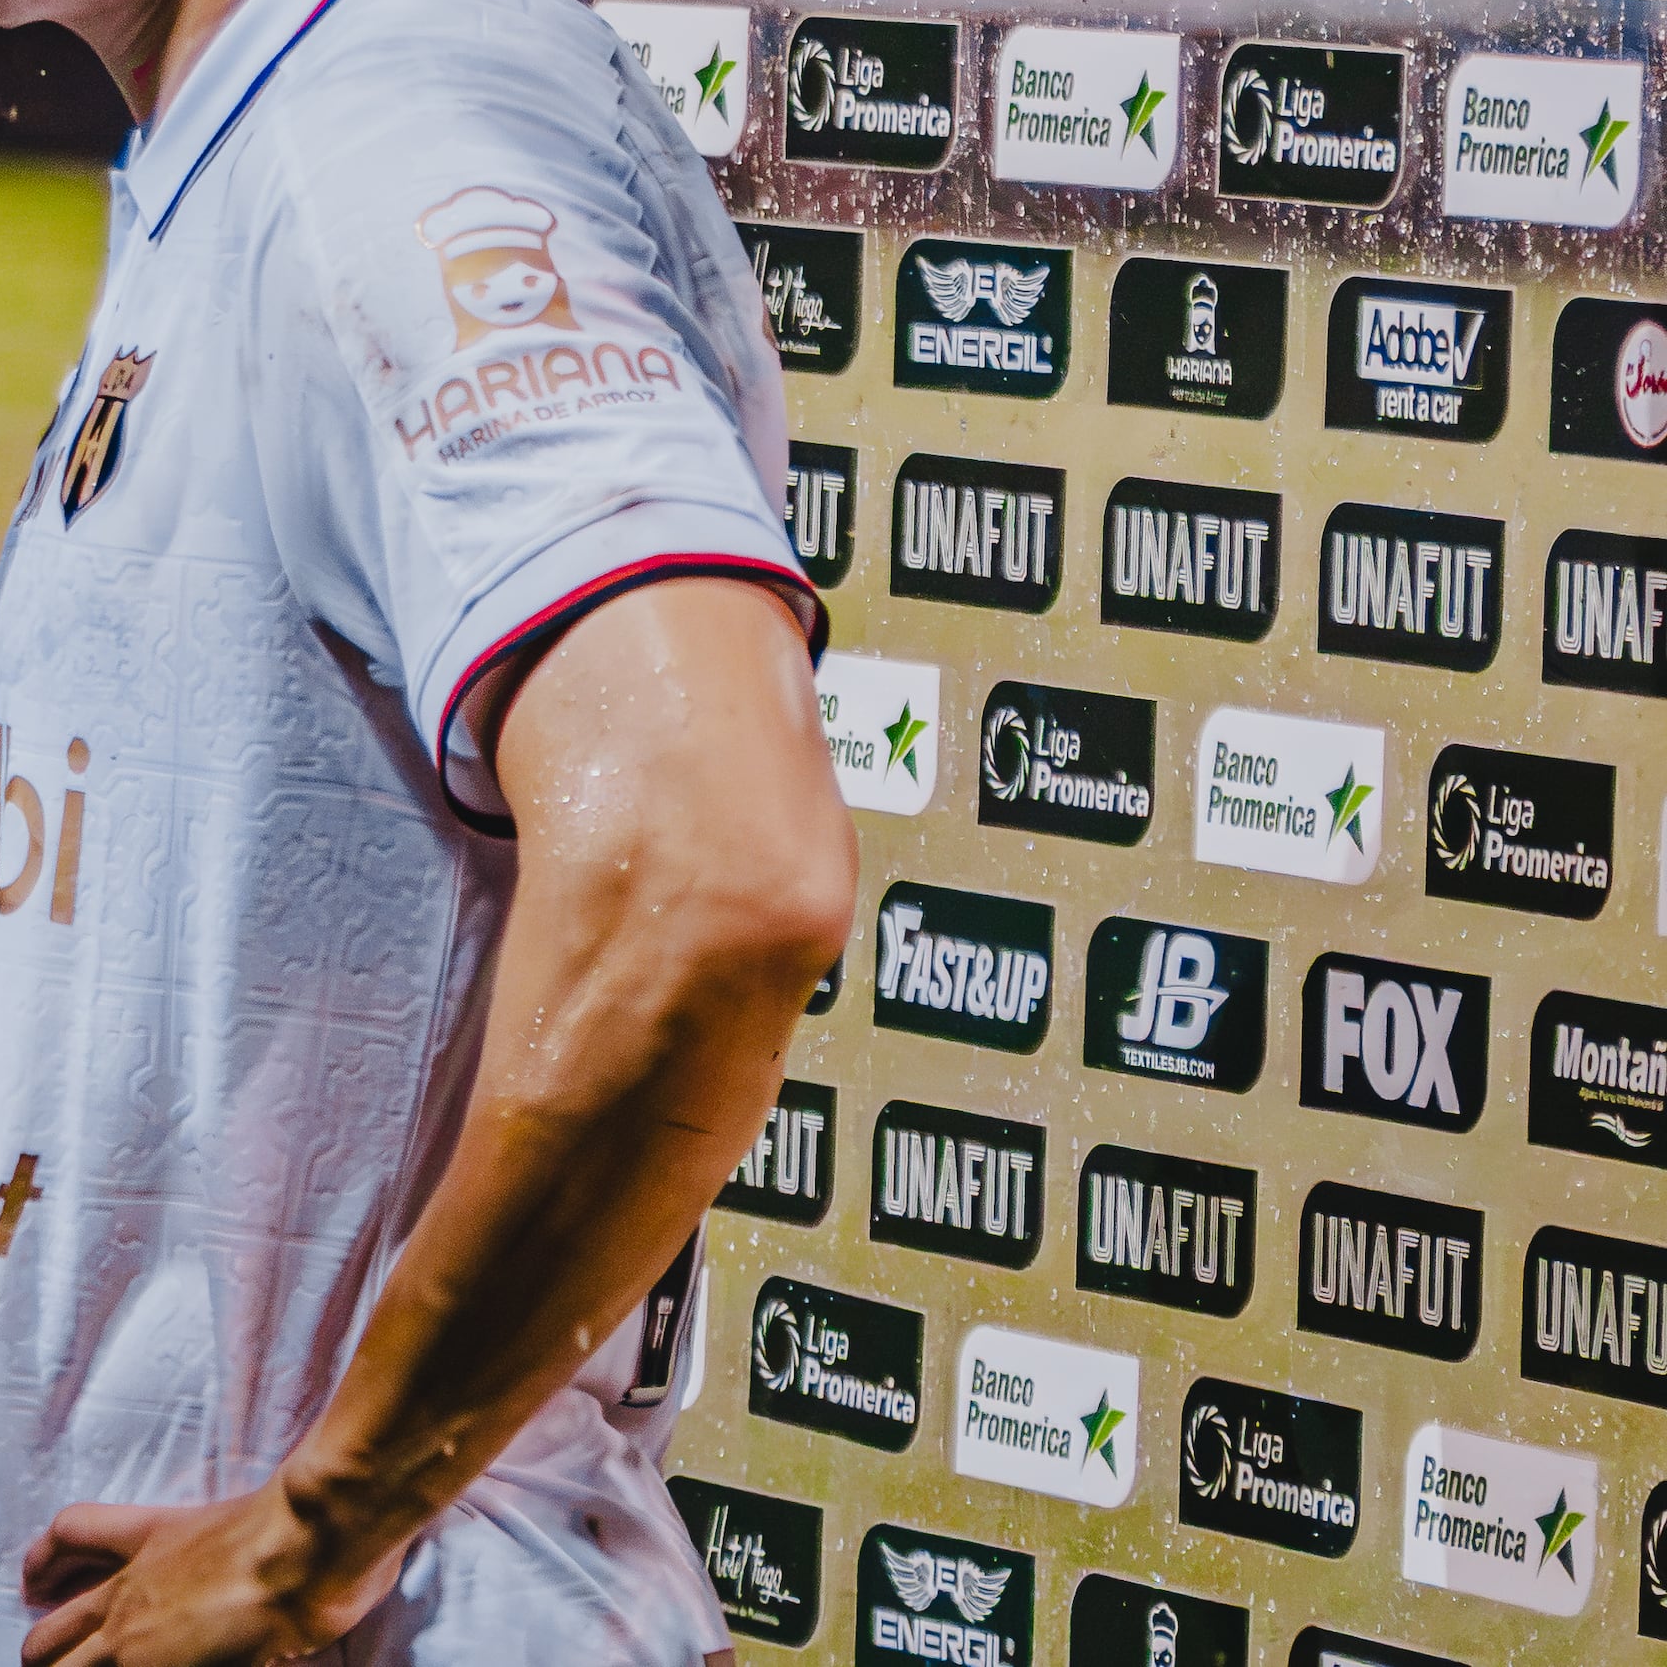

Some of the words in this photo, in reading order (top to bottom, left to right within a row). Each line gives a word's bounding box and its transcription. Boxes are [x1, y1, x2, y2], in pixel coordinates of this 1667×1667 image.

[838, 47, 884, 90] Liga
[1012, 60, 1075, 101] Banco
[835, 93, 951, 138] Promerica
[1006, 103, 1112, 148] Promerica
[1277, 78, 1325, 121] Liga
[1463, 87, 1531, 131] Banco
[1273, 126, 1396, 173] Promerica
[1456, 134, 1570, 180] Promerica
[910, 322, 1053, 374] ENERGIL
[1366, 307, 1451, 375] Adobe
[1168, 356, 1232, 386] HARIANA
[395, 343, 681, 462] HARIANA
[1378, 387, 1414, 421] rent
[1417, 397, 1429, 421] a
[1431, 393, 1463, 425] car
[439, 410, 529, 465] HARINA
[534, 402, 571, 422] DE
[904, 482, 1053, 584] UNAFUT
[1112, 505, 1269, 611] UNAFUT
[1333, 532, 1491, 640] UNAFUT
[1034, 718, 1081, 761] Liga
[1212, 742, 1278, 787] Banco
[1030, 760, 1150, 818] Promerica
[1207, 785, 1316, 838] Promerica
[1488, 786, 1535, 831] Liga
[1483, 833, 1608, 889] Promerica
[879, 903, 1048, 1024] FAST&UP
[1119, 931, 1223, 1050] JB
[1121, 1047, 1215, 1080] TEXTILESJB.COM
[1322, 967, 1463, 1114] FOX
[882, 1128, 1033, 1240] UNAFUT
[1089, 1171, 1244, 1287] UNAFUT
[1312, 1212, 1470, 1330] UNAFUT
[804, 1315, 849, 1365] Liga
[801, 1361, 916, 1425] Promerica
[971, 1358, 1035, 1407] Banco
[966, 1400, 1072, 1459] Promerica
[1239, 1417, 1284, 1470] Liga
[1234, 1463, 1356, 1528] Promerica
[1420, 1455, 1487, 1506] Banco
[1414, 1499, 1528, 1563] Promerica
[872, 1605, 1014, 1667] ENERGIL
